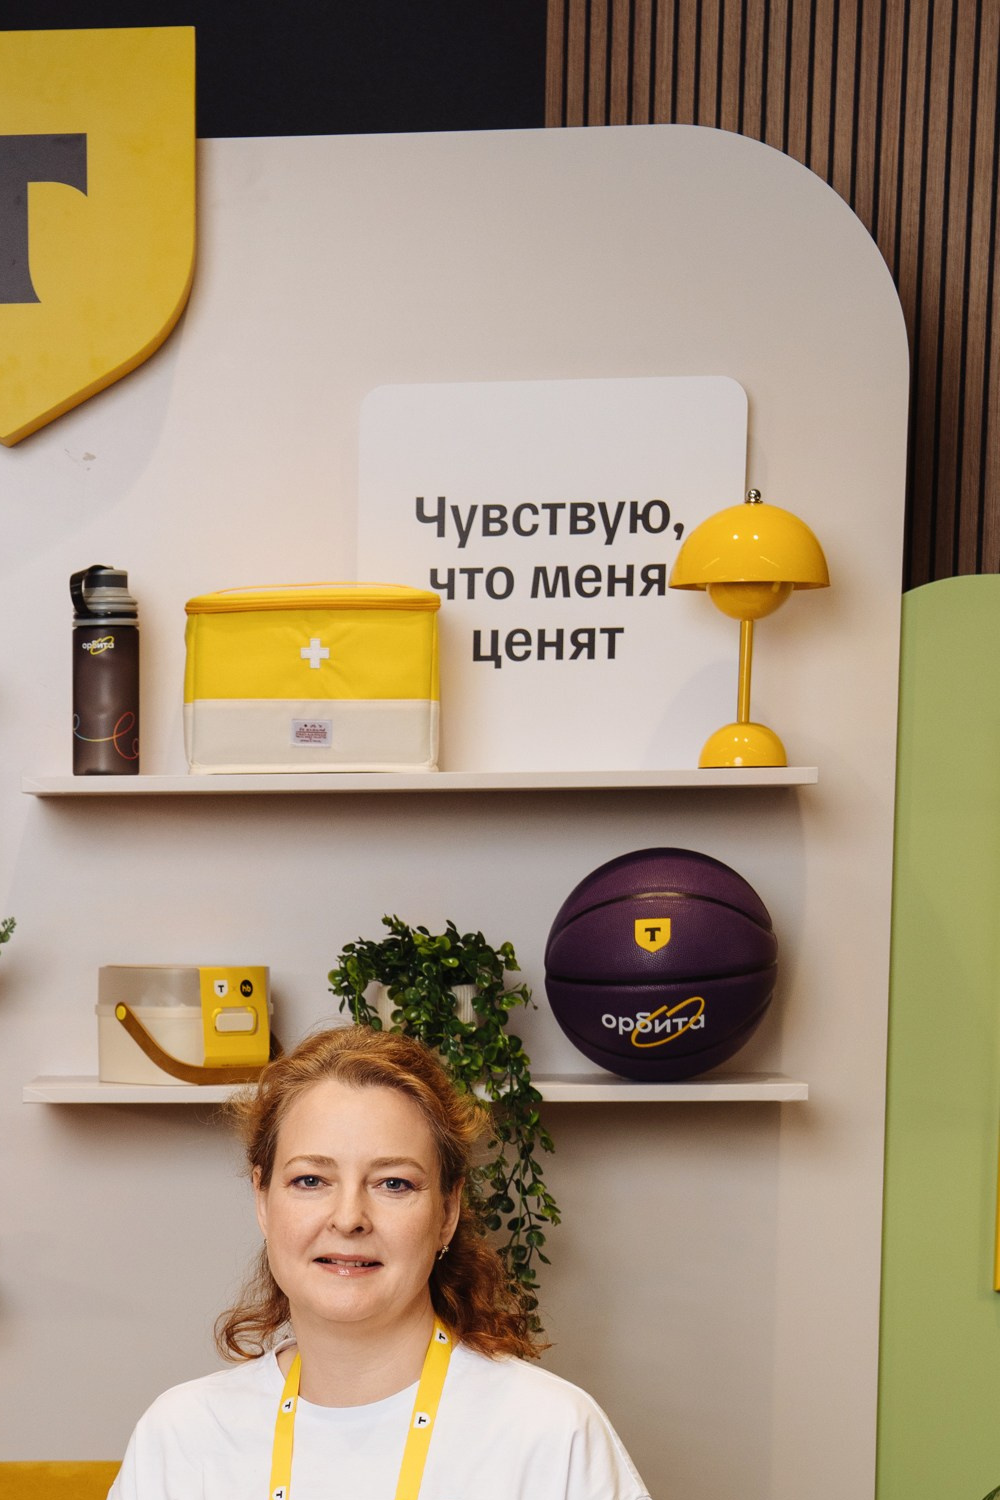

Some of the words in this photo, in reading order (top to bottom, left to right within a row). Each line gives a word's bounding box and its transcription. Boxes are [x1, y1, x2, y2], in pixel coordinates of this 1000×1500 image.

[415, 496, 685, 548] Чувствую,
[429, 566, 515, 600] что
[530, 563, 667, 599] меня
[82, 639, 115, 651] орбита
[472, 627, 625, 669] ценят
[601, 1009, 706, 1037] орбита
